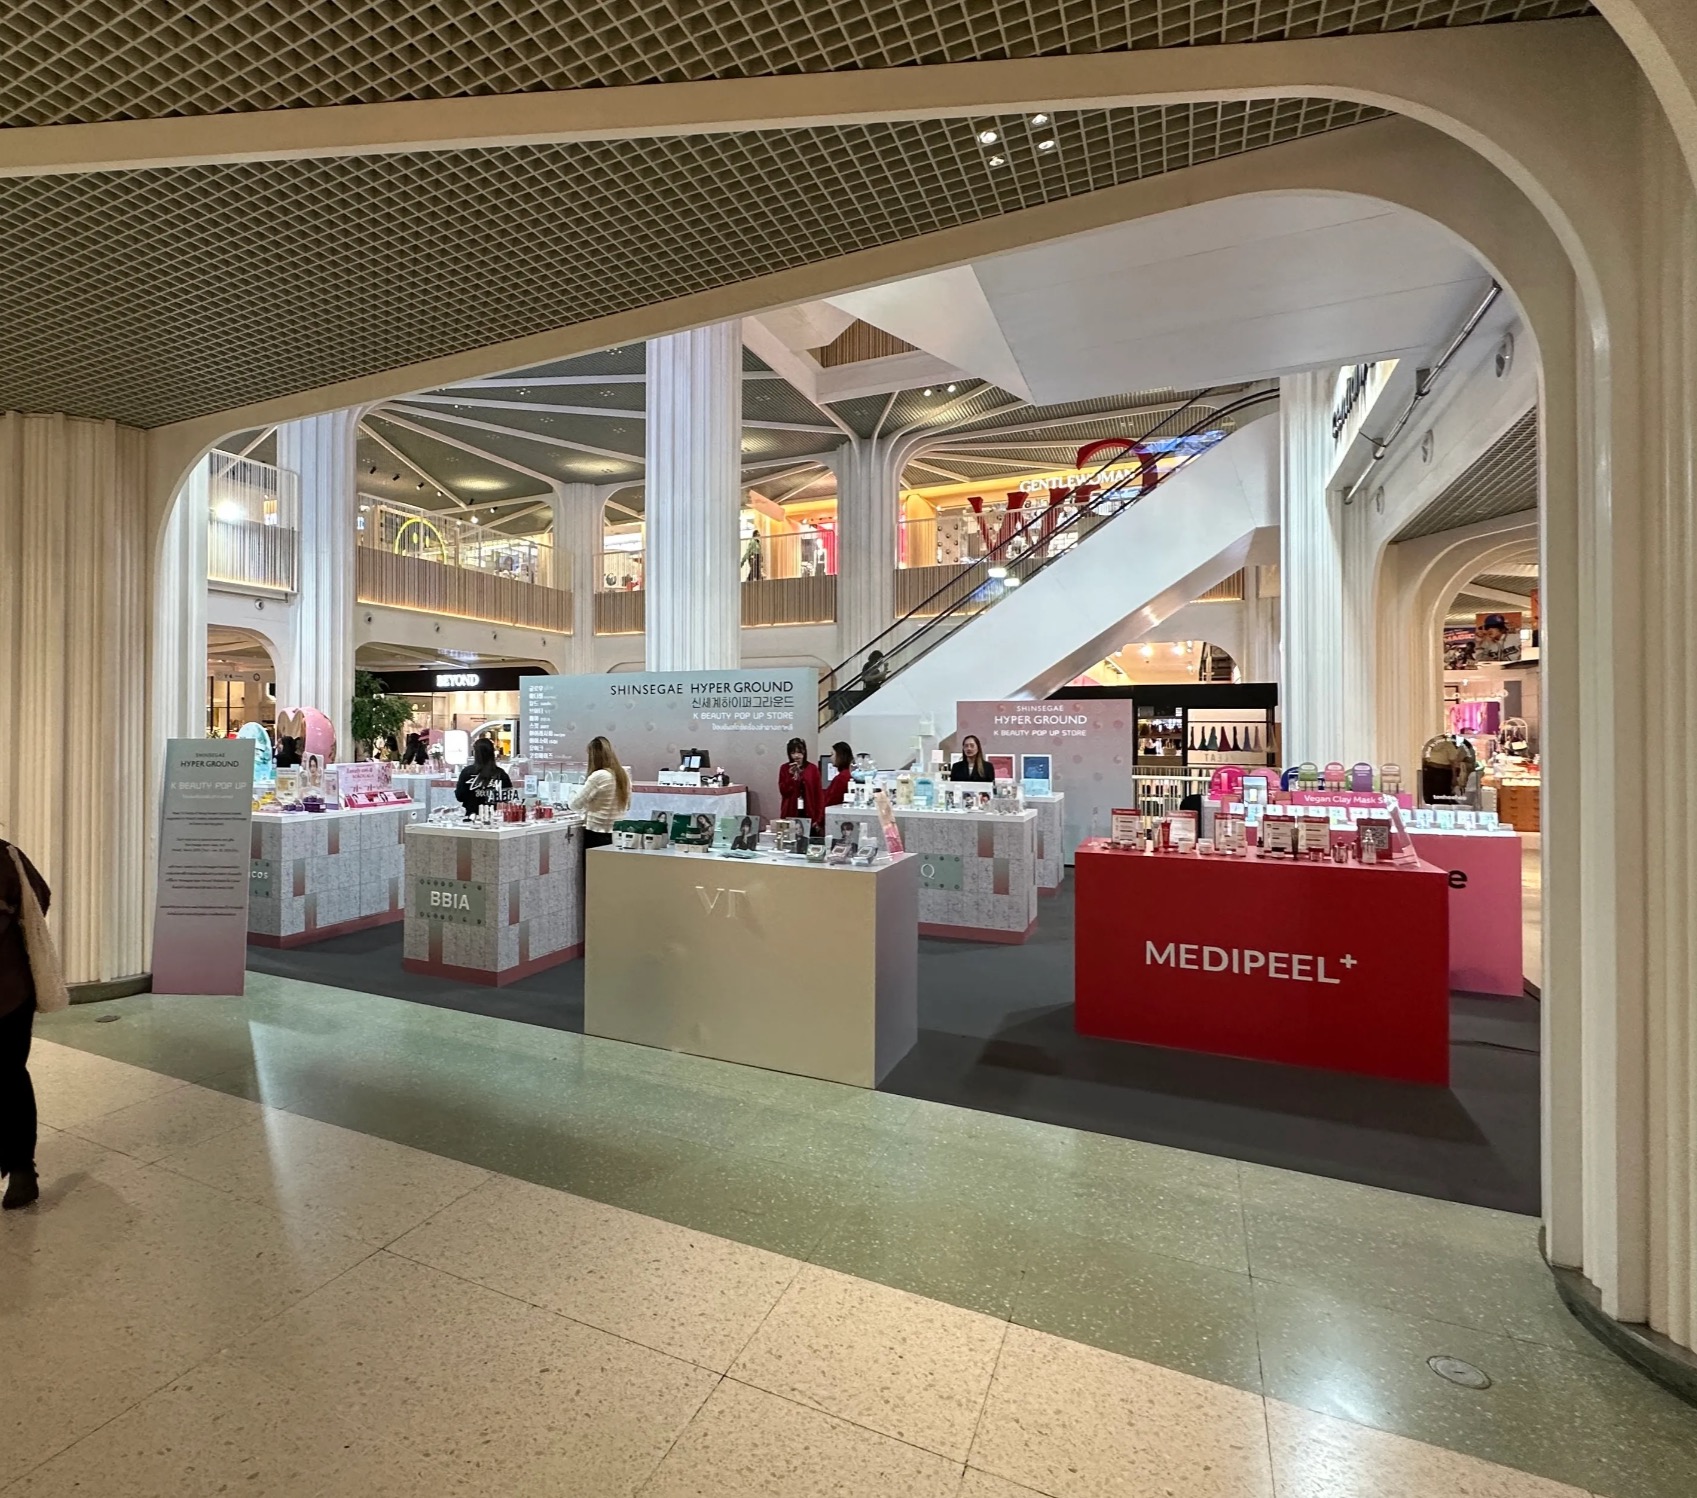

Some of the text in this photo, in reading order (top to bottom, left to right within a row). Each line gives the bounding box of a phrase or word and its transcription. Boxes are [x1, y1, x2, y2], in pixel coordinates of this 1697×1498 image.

[436, 673, 480, 687] BEYOND
[610, 681, 794, 696] SHINSEGAE HYPER GROUND
[692, 695, 794, 708] 신세계하이퍼그라운드
[693, 711, 794, 720] K BEAUTY POP UP STORE
[994, 715, 1088, 724] HYPER GROUND
[180, 760, 240, 768] HYPER GROUND
[170, 781, 247, 790] K BEAUTY POP UP
[1304, 795, 1331, 804] Vegan
[1332, 795, 1352, 805] Clay
[1353, 796, 1376, 804] Mask
[430, 890, 470, 911] BBIA
[694, 885, 747, 920] VT
